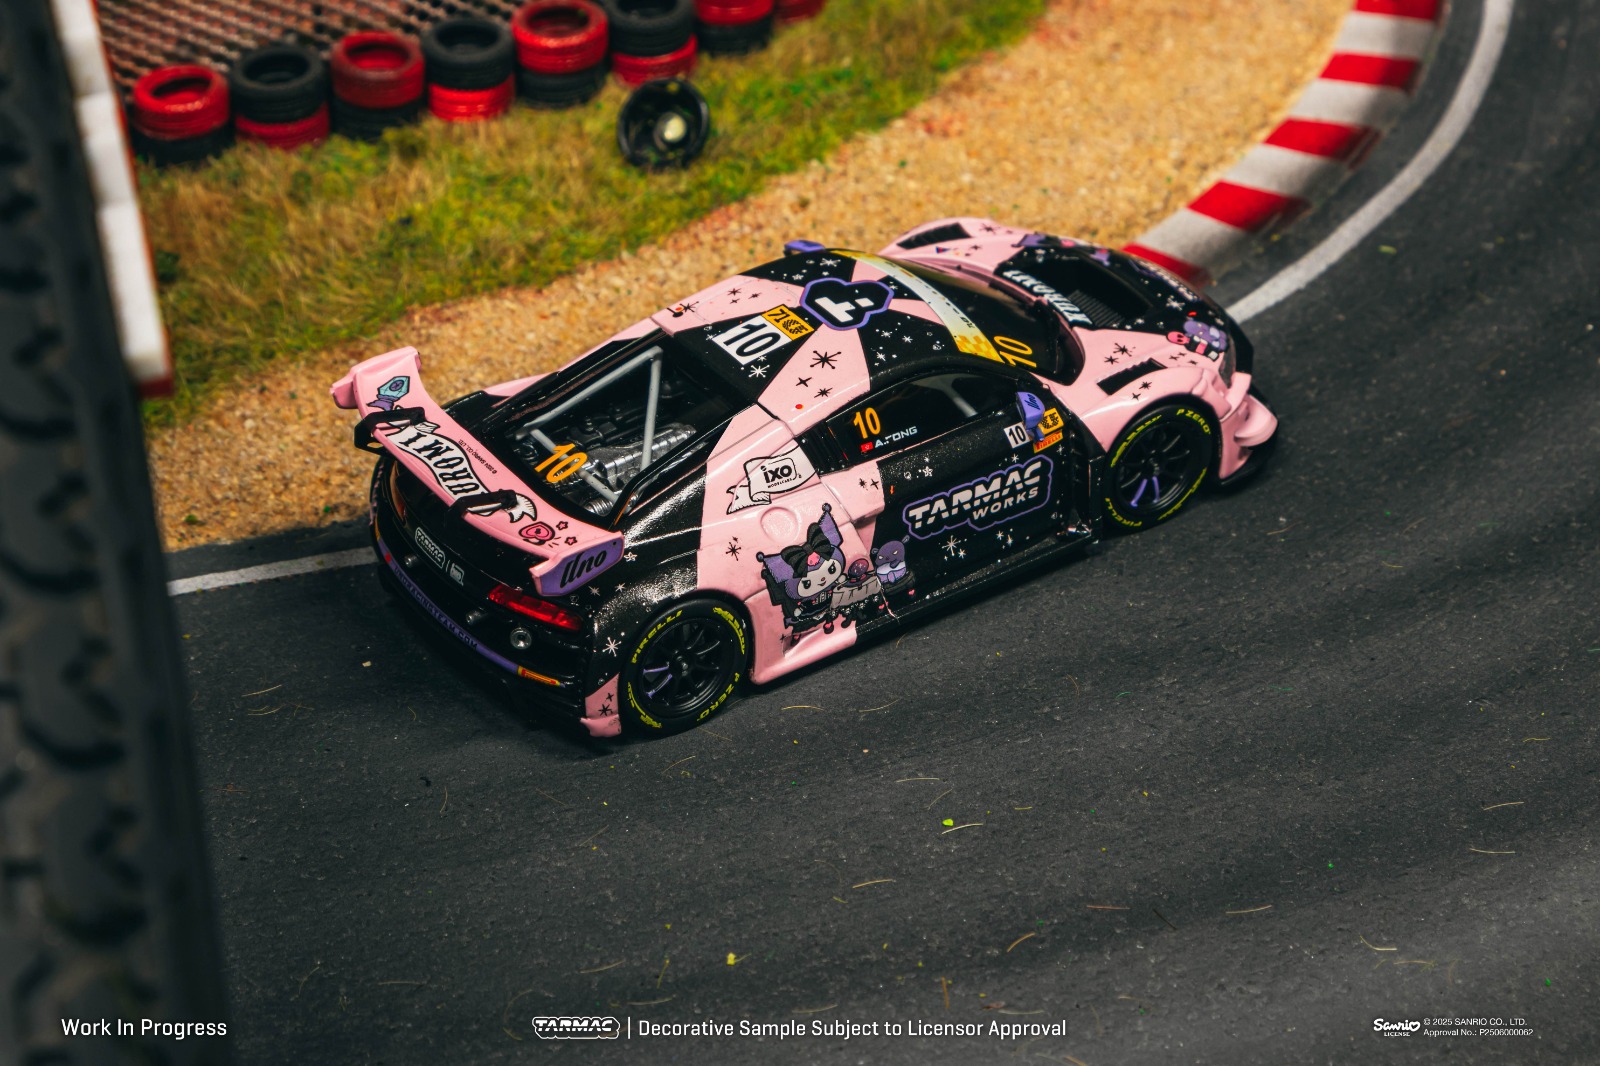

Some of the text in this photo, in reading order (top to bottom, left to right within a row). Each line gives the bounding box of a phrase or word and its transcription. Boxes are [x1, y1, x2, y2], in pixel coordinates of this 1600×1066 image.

[723, 323, 781, 357] 10
[994, 335, 1037, 368] 10
[853, 407, 881, 439] 10
[1008, 425, 1026, 445] 10
[398, 431, 484, 496] UROMI
[534, 442, 588, 483] 10
[760, 464, 793, 484] ixo
[908, 461, 1042, 529] TARMAC
[972, 486, 1039, 520] WORKS
[631, 609, 683, 665] PIRELLI
[696, 684, 735, 722] ZERO
